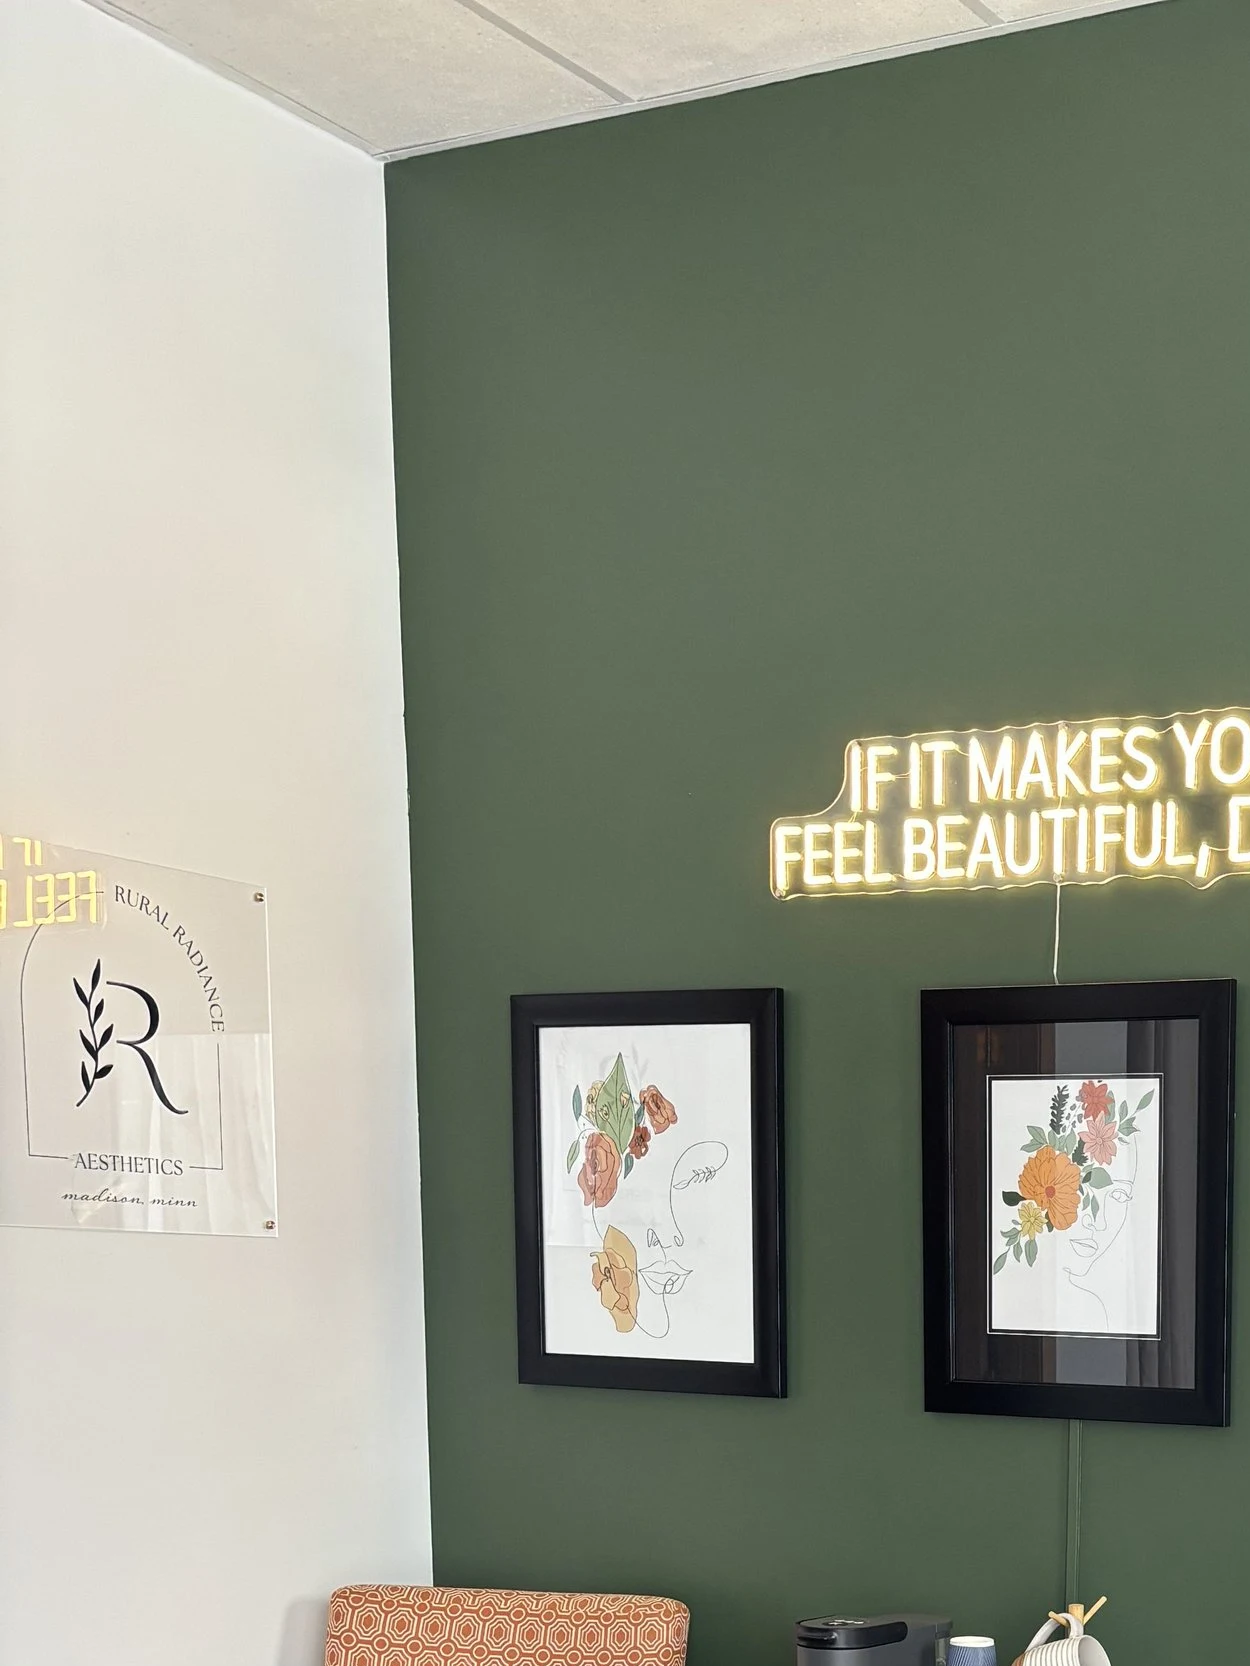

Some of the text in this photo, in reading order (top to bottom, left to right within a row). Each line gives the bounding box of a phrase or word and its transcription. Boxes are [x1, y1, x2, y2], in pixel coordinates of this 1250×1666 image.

[851, 742, 898, 812] IF
[909, 741, 960, 809] IT
[968, 725, 1161, 803] MAKES
[775, 819, 898, 891] FEEL
[903, 799, 1210, 881] BEAUTIFUL,
[115, 885, 225, 1033] RURAL RADIANCE
[74, 1152, 184, 1176] AESTHETICS
